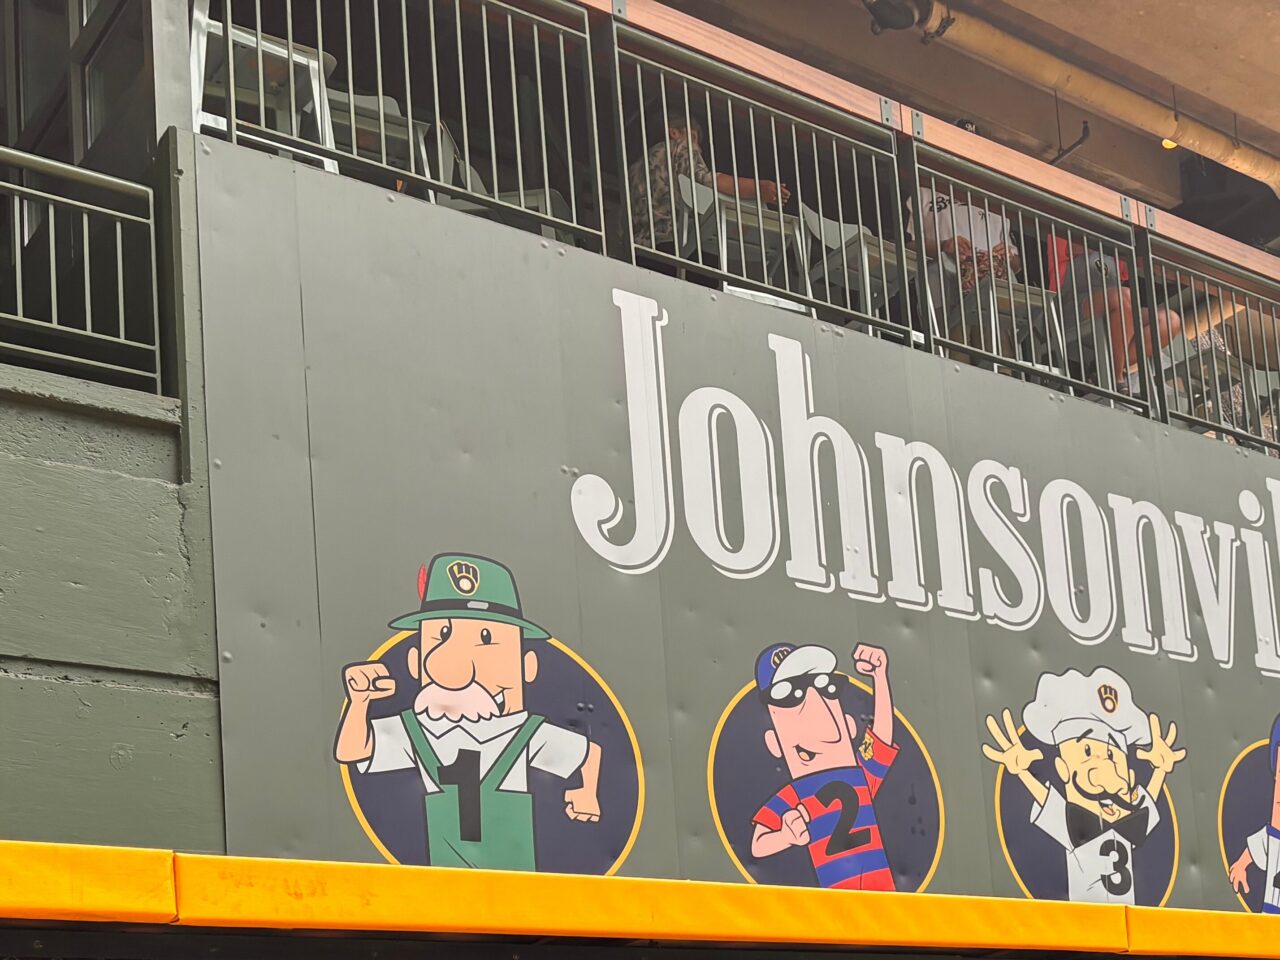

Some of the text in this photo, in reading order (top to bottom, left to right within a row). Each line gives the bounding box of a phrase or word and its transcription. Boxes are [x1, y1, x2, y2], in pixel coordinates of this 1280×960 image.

[438, 748, 482, 842] 1
[813, 780, 872, 857] 2
[1098, 838, 1132, 897] 3
